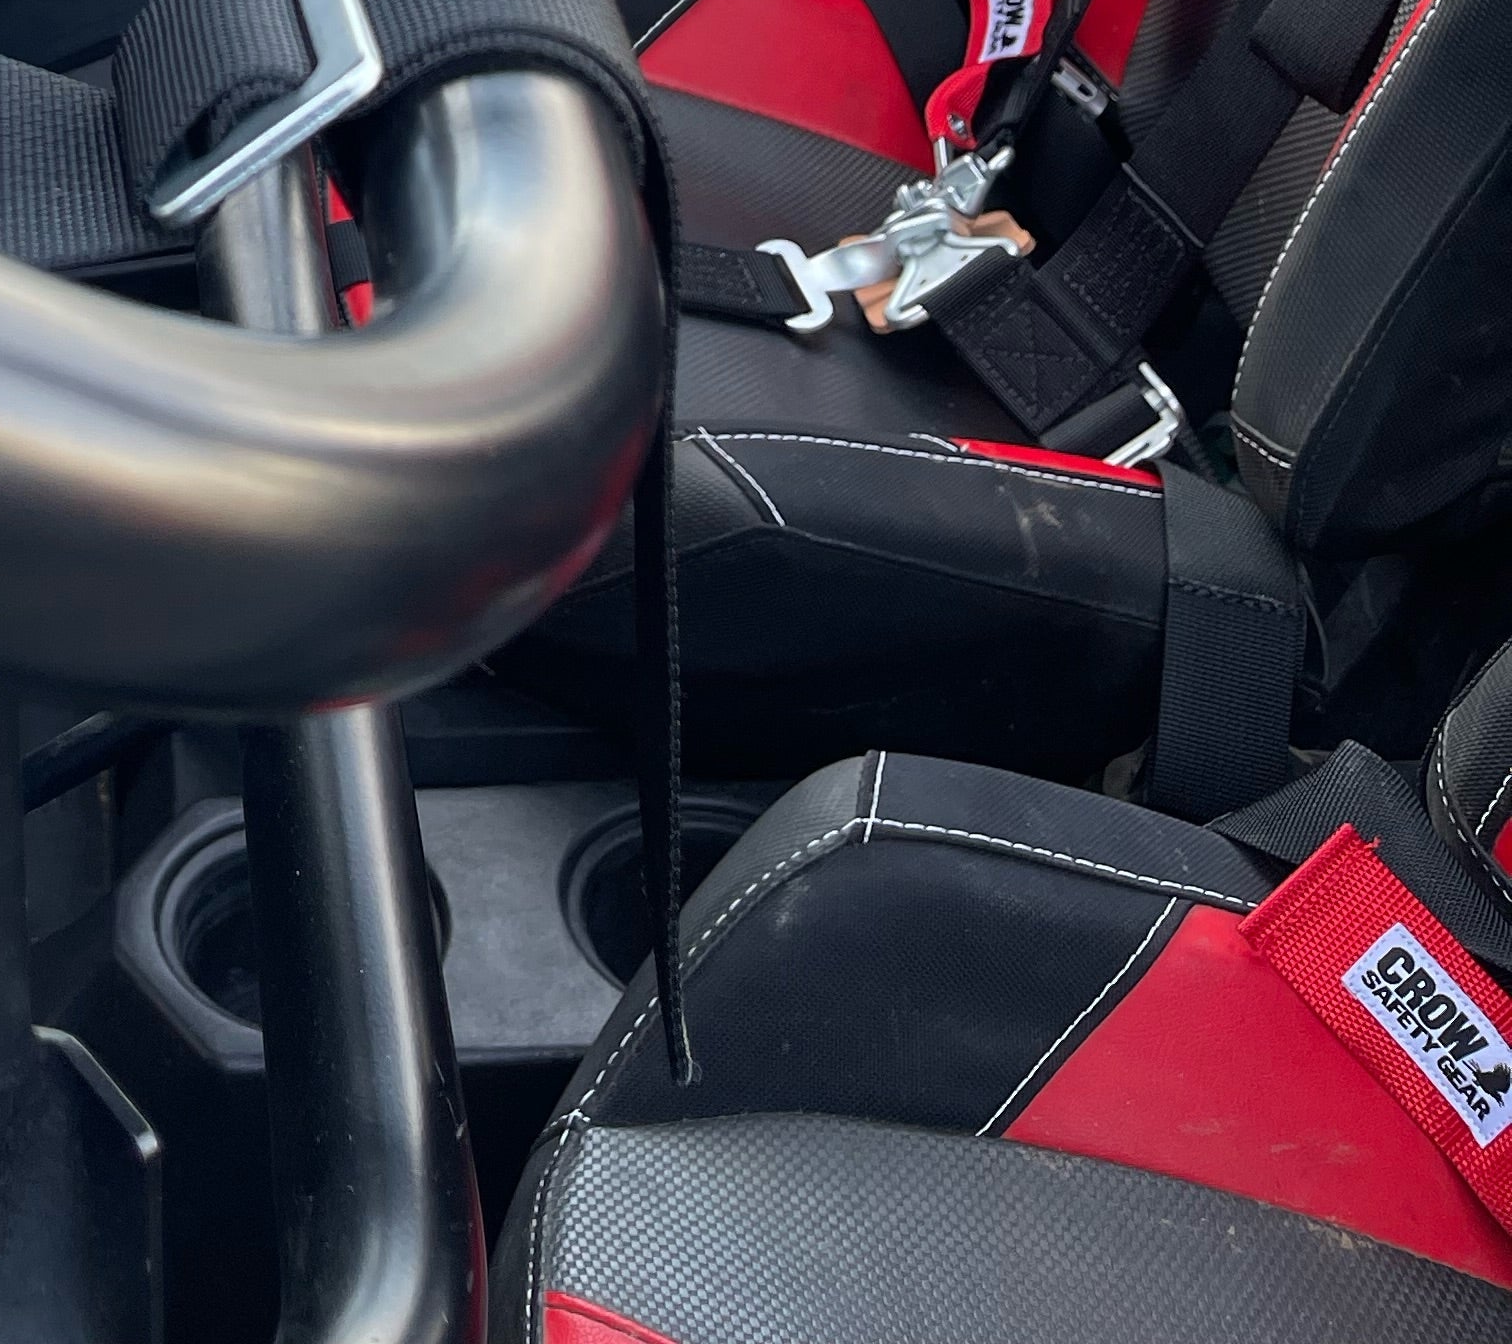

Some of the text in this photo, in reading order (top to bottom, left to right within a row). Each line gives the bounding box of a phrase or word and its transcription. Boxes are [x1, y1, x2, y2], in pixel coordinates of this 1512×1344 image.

[1361, 969, 1490, 1122] SAFETY GEAR
[1377, 946, 1489, 1061] CROW
